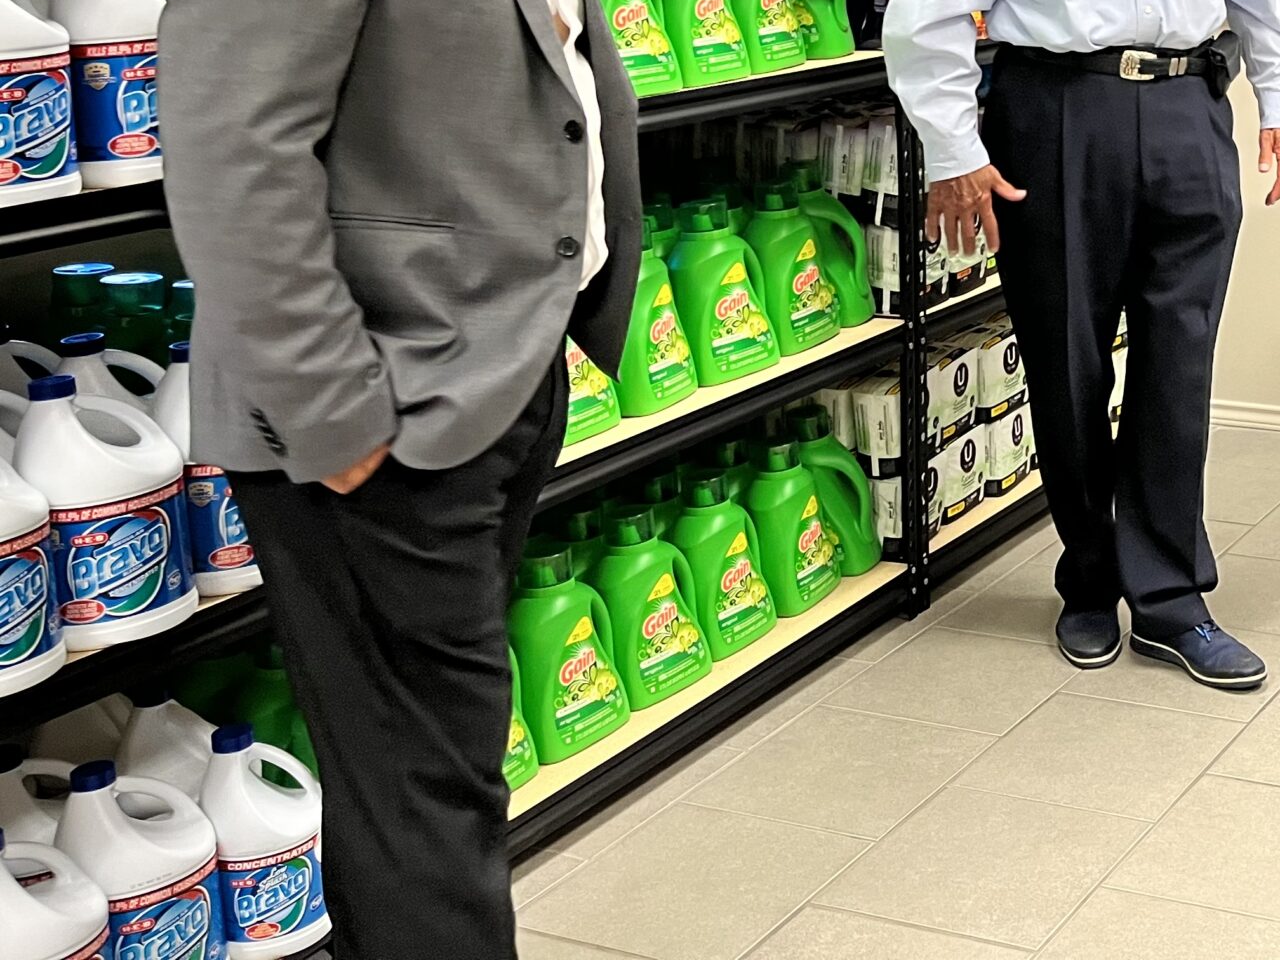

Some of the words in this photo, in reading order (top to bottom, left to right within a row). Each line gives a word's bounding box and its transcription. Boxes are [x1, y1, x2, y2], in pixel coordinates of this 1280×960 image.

[614, 3, 647, 28] Gain
[793, 265, 819, 294] Gain
[716, 290, 748, 319] Gain
[651, 314, 676, 342] Gain
[799, 521, 822, 553] Gain
[72, 524, 166, 600] Bravo
[722, 559, 751, 592] Gain
[643, 603, 677, 639] Gain
[561, 649, 595, 685] Gain
[227, 839, 314, 871] CONCENTRATED
[237, 867, 308, 927] Bravo
